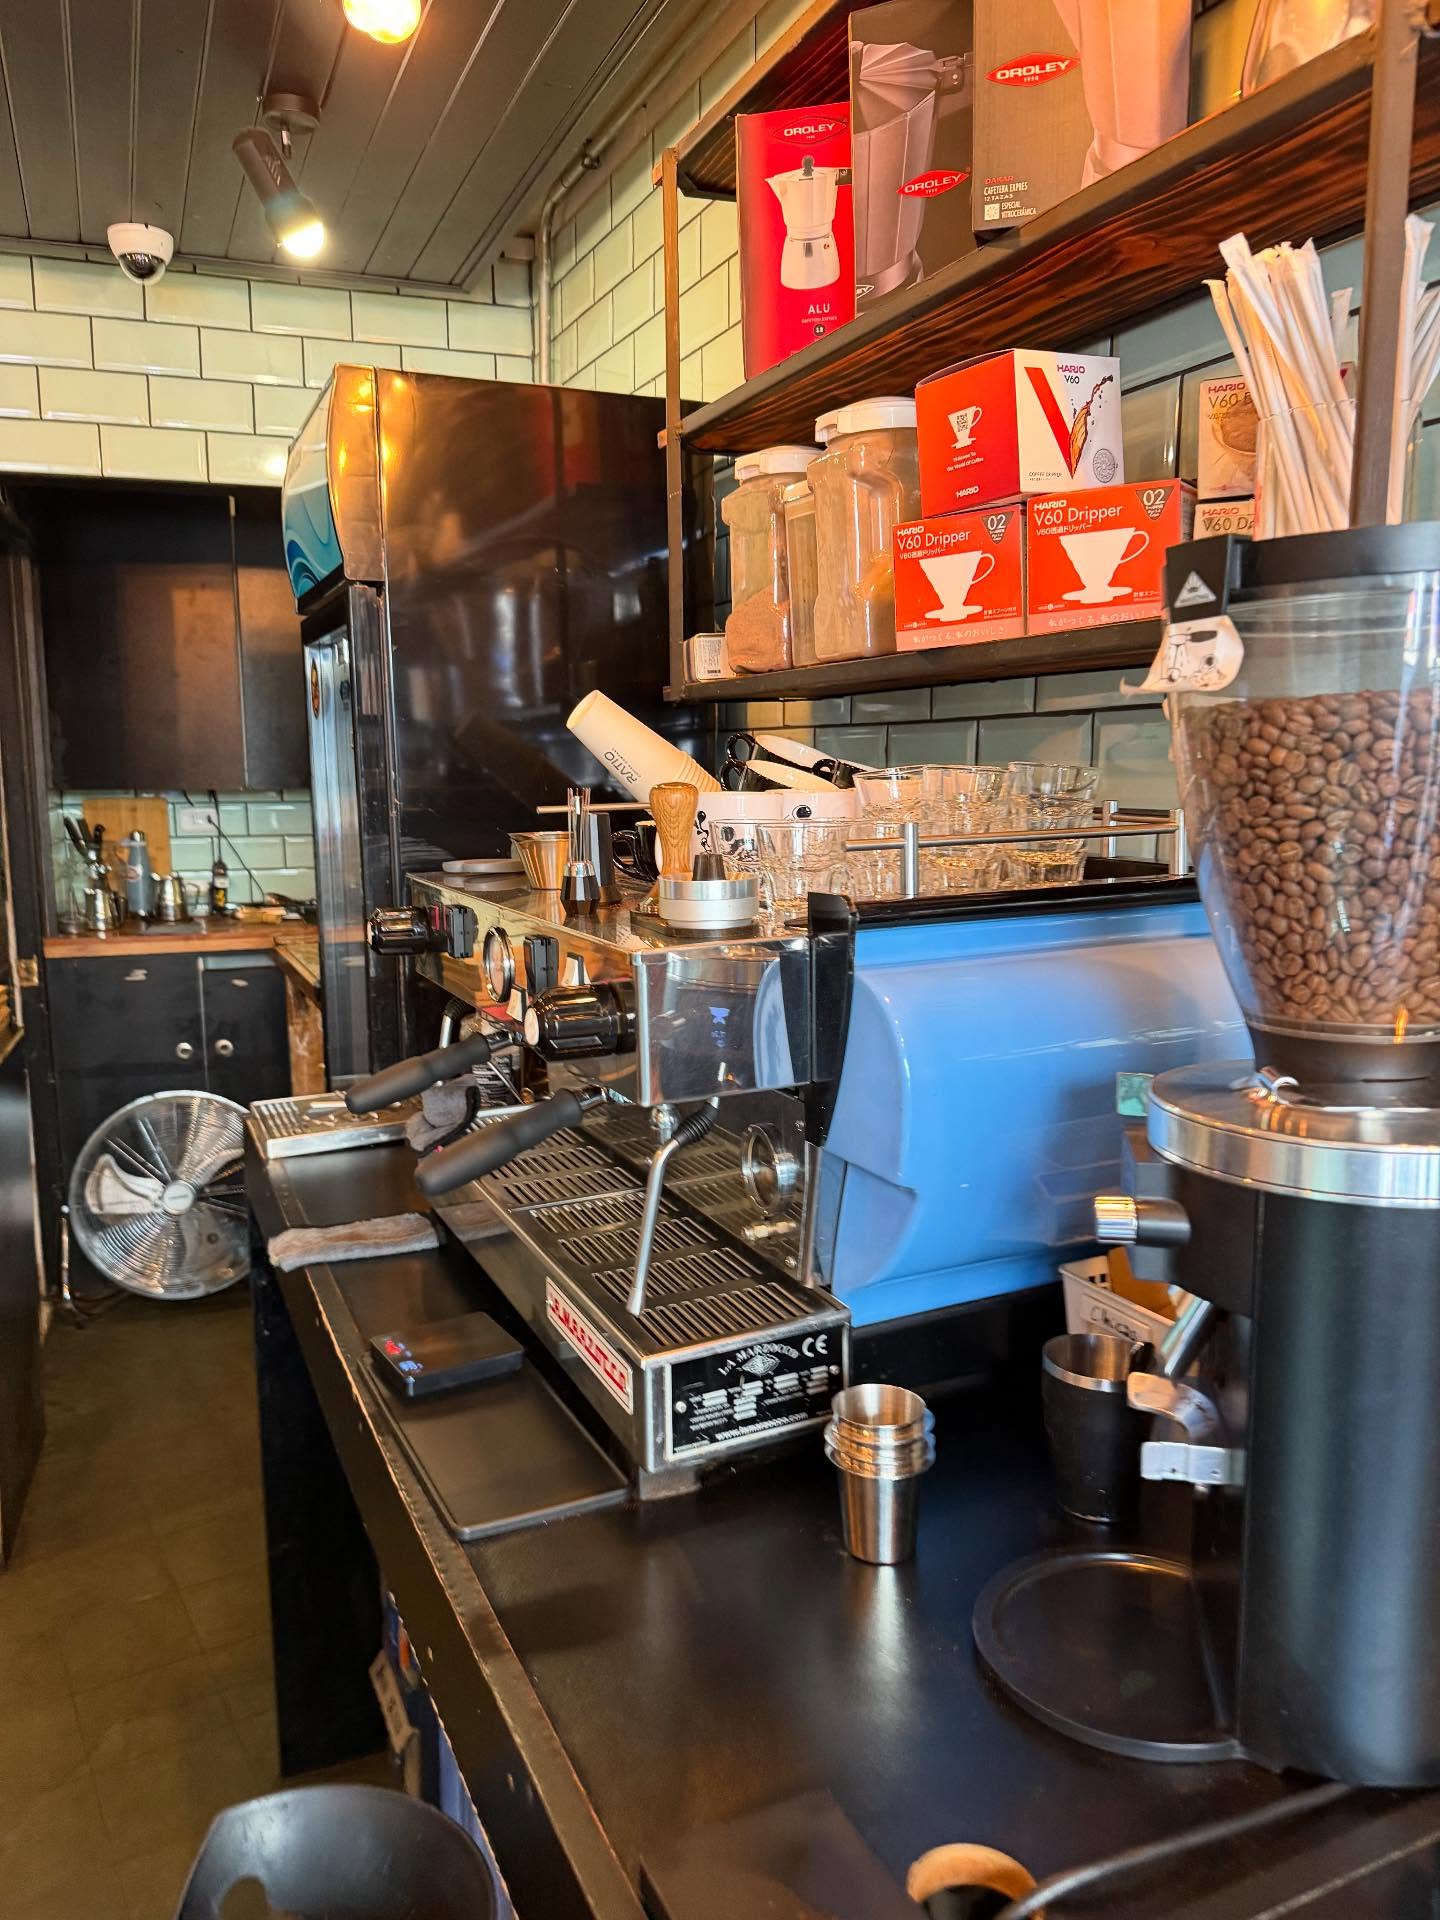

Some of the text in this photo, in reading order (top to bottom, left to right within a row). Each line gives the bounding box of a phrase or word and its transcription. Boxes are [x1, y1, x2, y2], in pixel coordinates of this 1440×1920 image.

[996, 60, 1070, 80] OROLEY
[783, 123, 836, 137] OROLEY
[904, 173, 962, 193] OROLEY
[808, 303, 831, 315] ALU
[1056, 364, 1086, 374] HARIO
[1064, 375, 1081, 384] V60
[1208, 382, 1246, 394] HARIO
[1208, 392, 1239, 410] V60
[955, 485, 979, 498] HARIO
[1143, 488, 1165, 506] 02
[1034, 499, 1067, 511] HARIO
[1202, 507, 1239, 517] HARIO
[987, 514, 1006, 531] 02
[1034, 505, 1122, 526] V60 Dripper
[1203, 517, 1231, 531] V60
[897, 526, 924, 537] HARIO
[897, 535, 921, 550] V60
[925, 531, 970, 548] Dripper
[604, 751, 638, 784] RATIO
